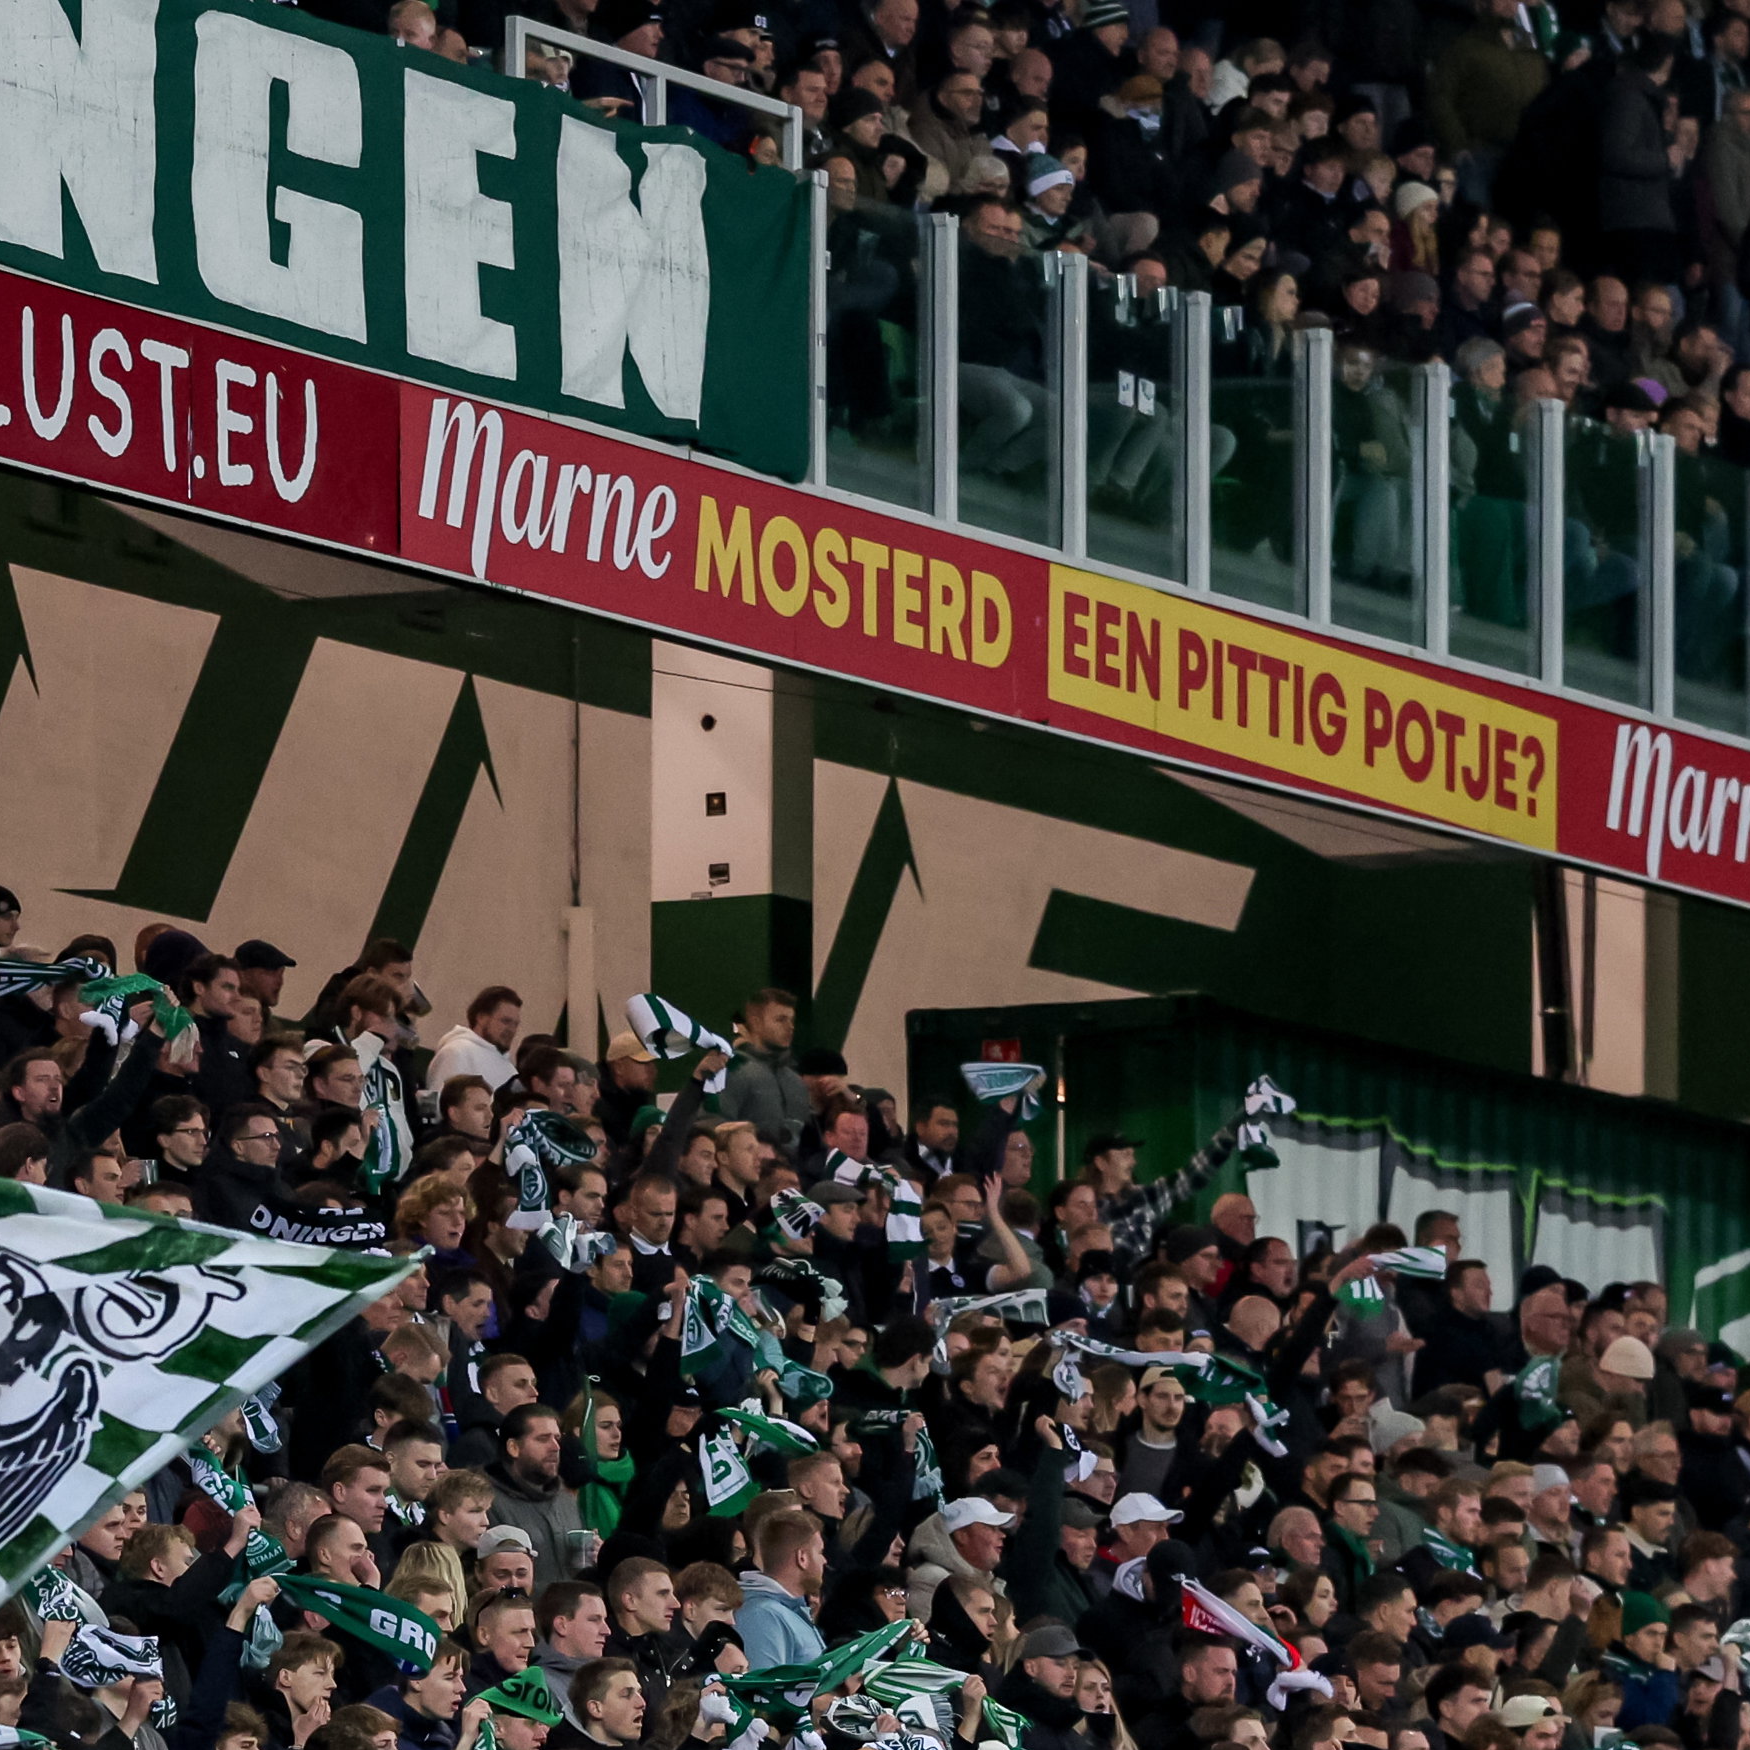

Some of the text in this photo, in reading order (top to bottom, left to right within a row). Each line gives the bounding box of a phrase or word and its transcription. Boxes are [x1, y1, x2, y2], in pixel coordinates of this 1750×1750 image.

[418, 398, 1013, 669] Marne MOSTERD
[1062, 591, 1546, 818] EEN PITTIG POTJE?
